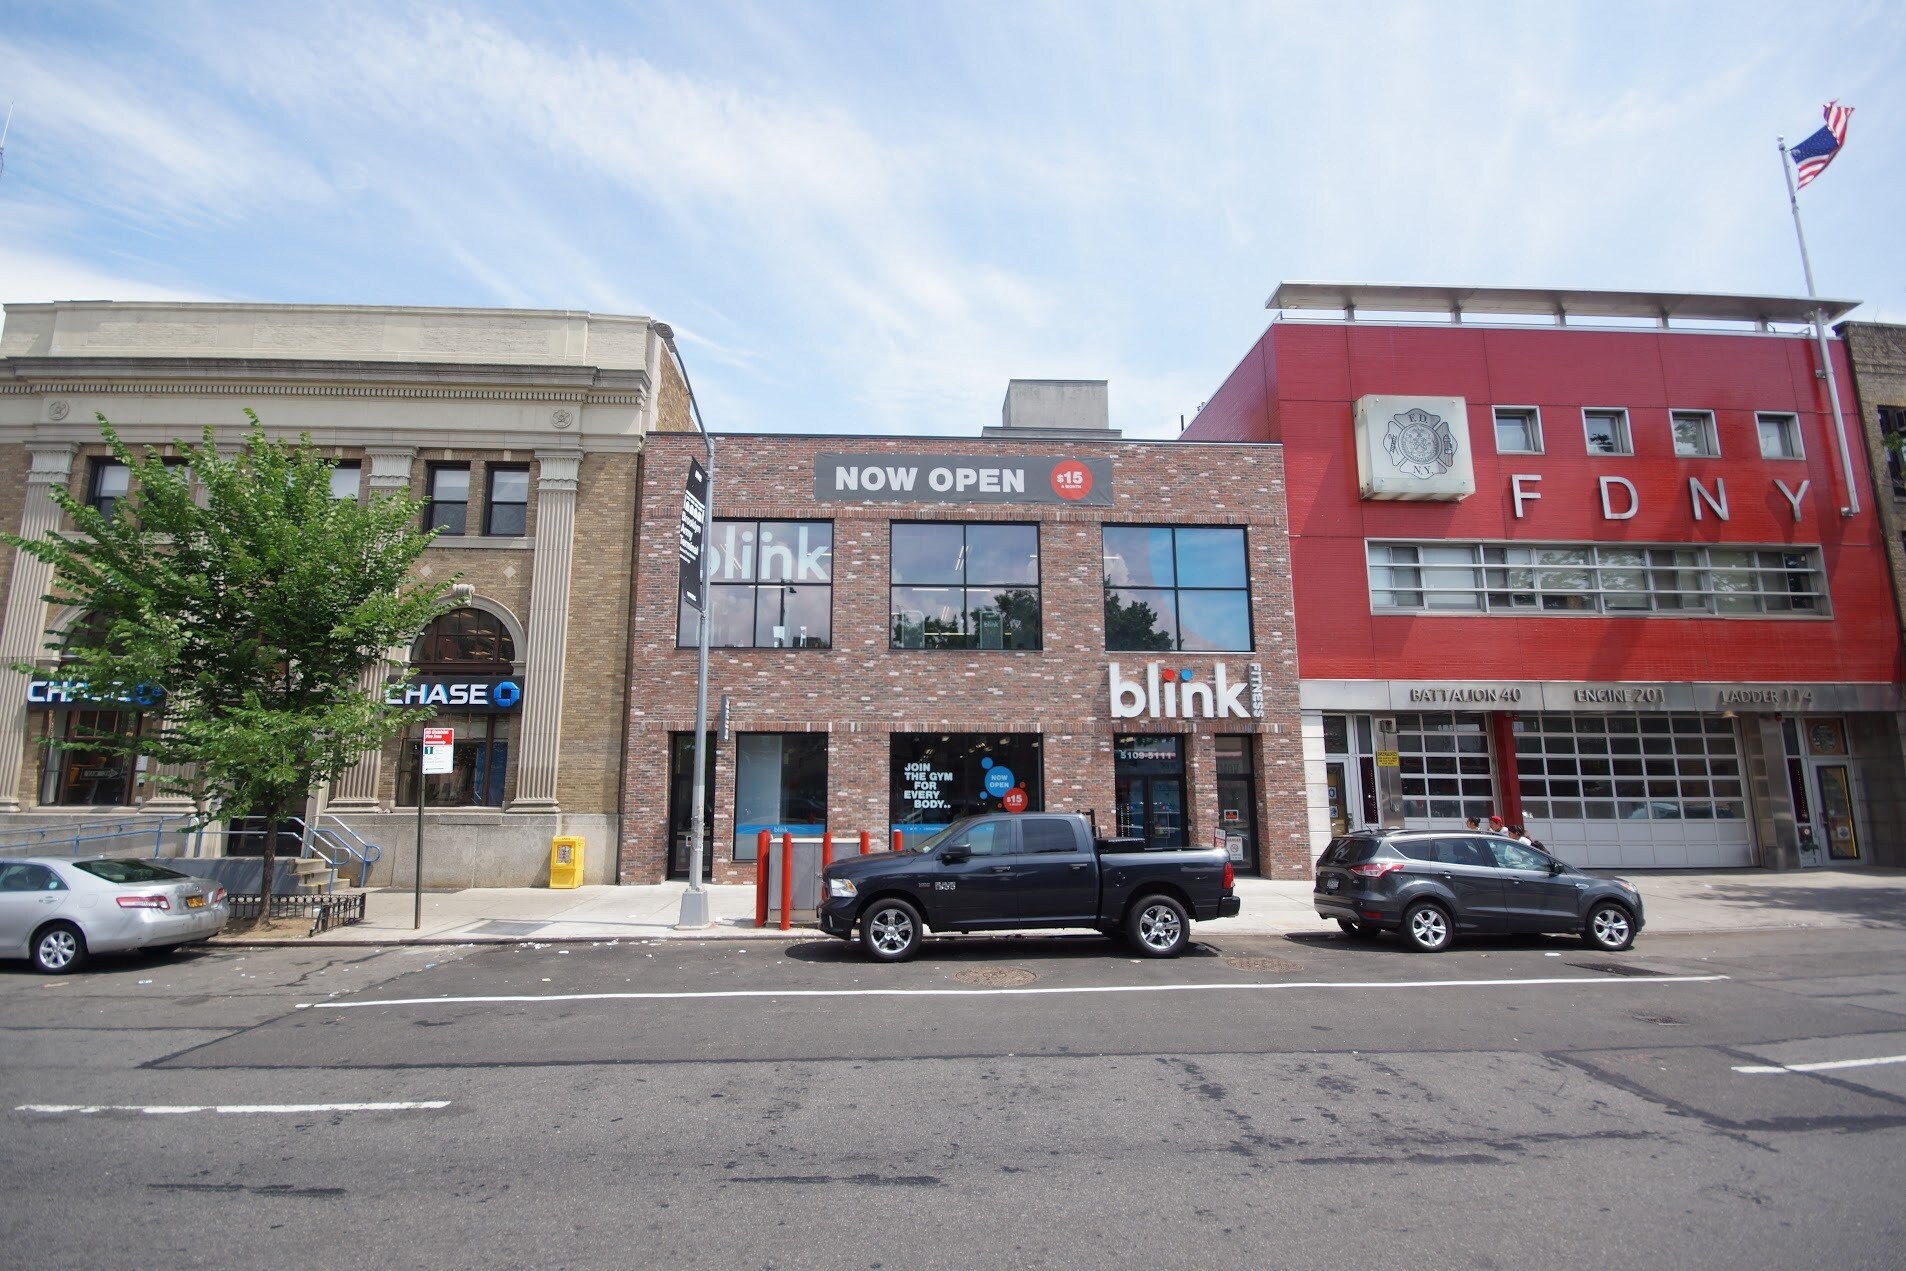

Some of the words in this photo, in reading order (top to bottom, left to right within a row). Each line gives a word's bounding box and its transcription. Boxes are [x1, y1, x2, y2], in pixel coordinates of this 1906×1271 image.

[836, 466, 918, 491] NOW
[928, 467, 1025, 493] OPEN
[1056, 471, 1083, 484] $15
[681, 510, 702, 534] Brooklyn
[680, 522, 694, 542] Army
[384, 683, 489, 705] CHASE
[1109, 662, 1251, 718] blink
[1249, 662, 1265, 719] FITNESS
[1409, 688, 1497, 702] BATTALION
[1500, 687, 1522, 702] 40
[1575, 689, 1633, 702] ENGINE
[1633, 688, 1665, 703] 201
[1720, 690, 1779, 703] LADDER
[1781, 688, 1814, 703] 114
[1119, 750, 1172, 760] 5109-5111
[904, 763, 931, 772] JOIN
[904, 772, 927, 782] THE
[929, 772, 953, 782] GYM
[914, 781, 937, 790] FOR
[903, 790, 940, 800] EVERY
